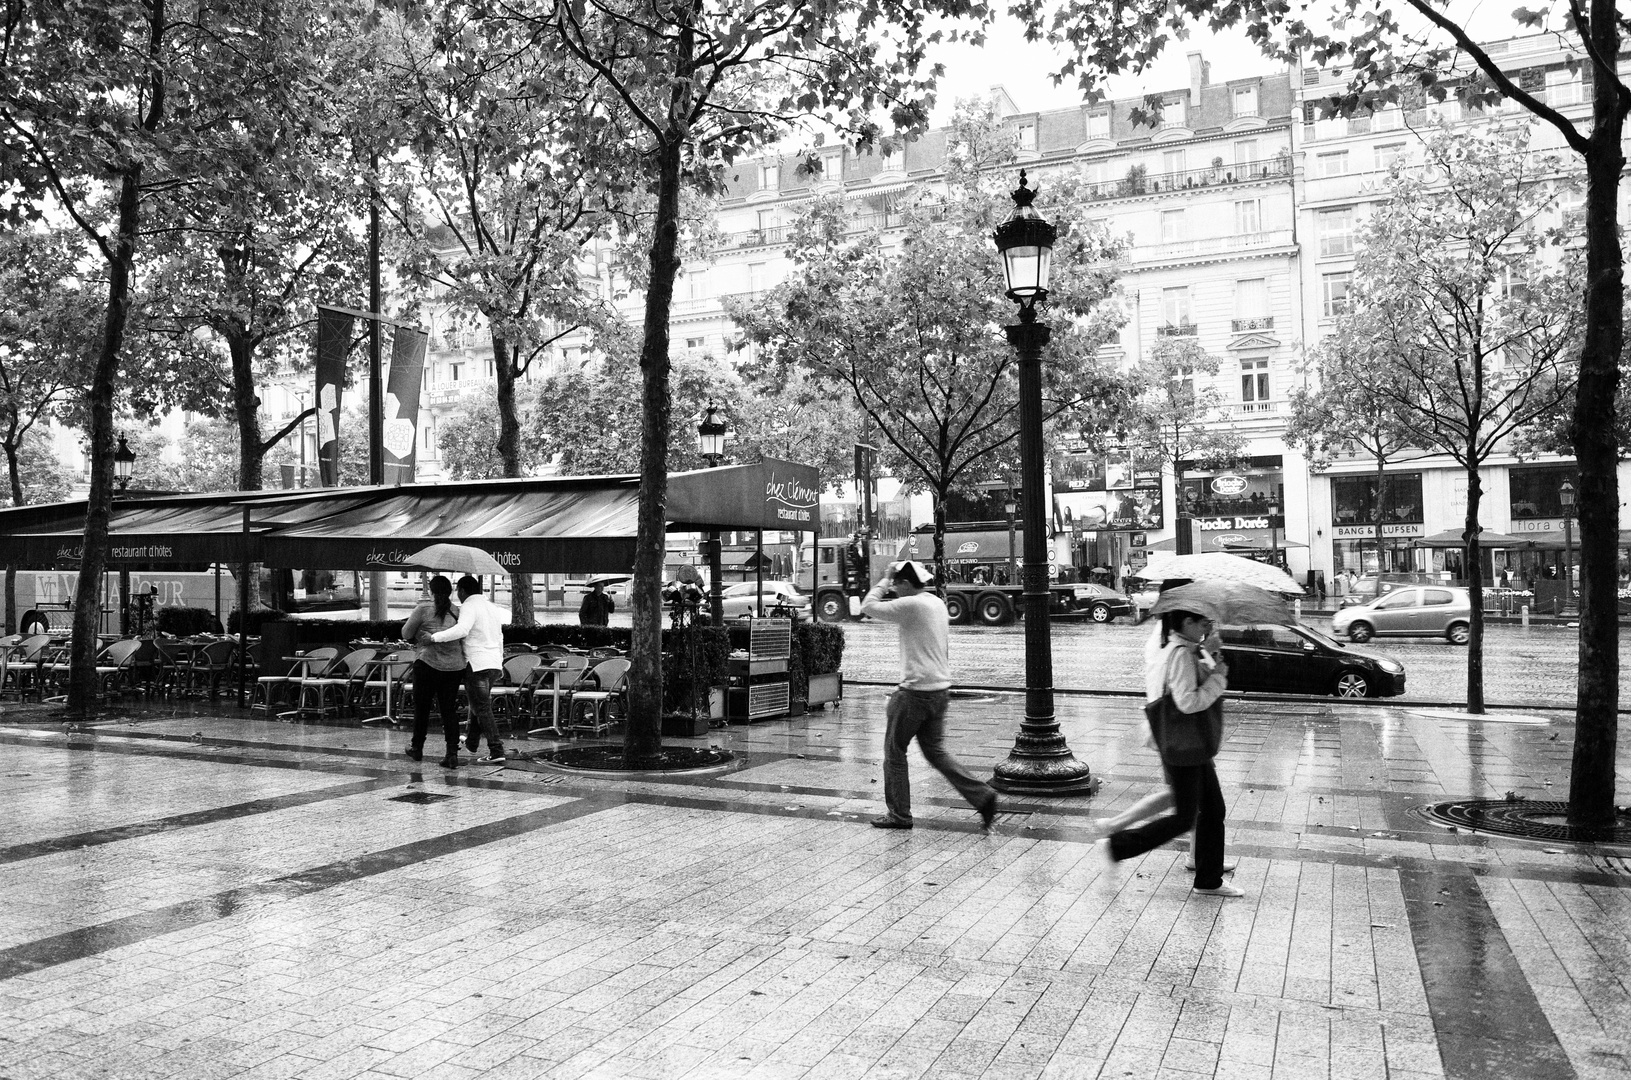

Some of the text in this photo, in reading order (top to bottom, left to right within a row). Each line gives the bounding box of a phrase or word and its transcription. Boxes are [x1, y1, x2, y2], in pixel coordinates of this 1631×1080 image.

[438, 381, 457, 391] LOUER
[766, 471, 787, 500] chez
[777, 508, 797, 520] restaurant
[1338, 525, 1418, 536] BANG & LUFSEN
[1518, 519, 1551, 531] flora
[111, 545, 147, 558] restaurant
[366, 547, 387, 562] chez
